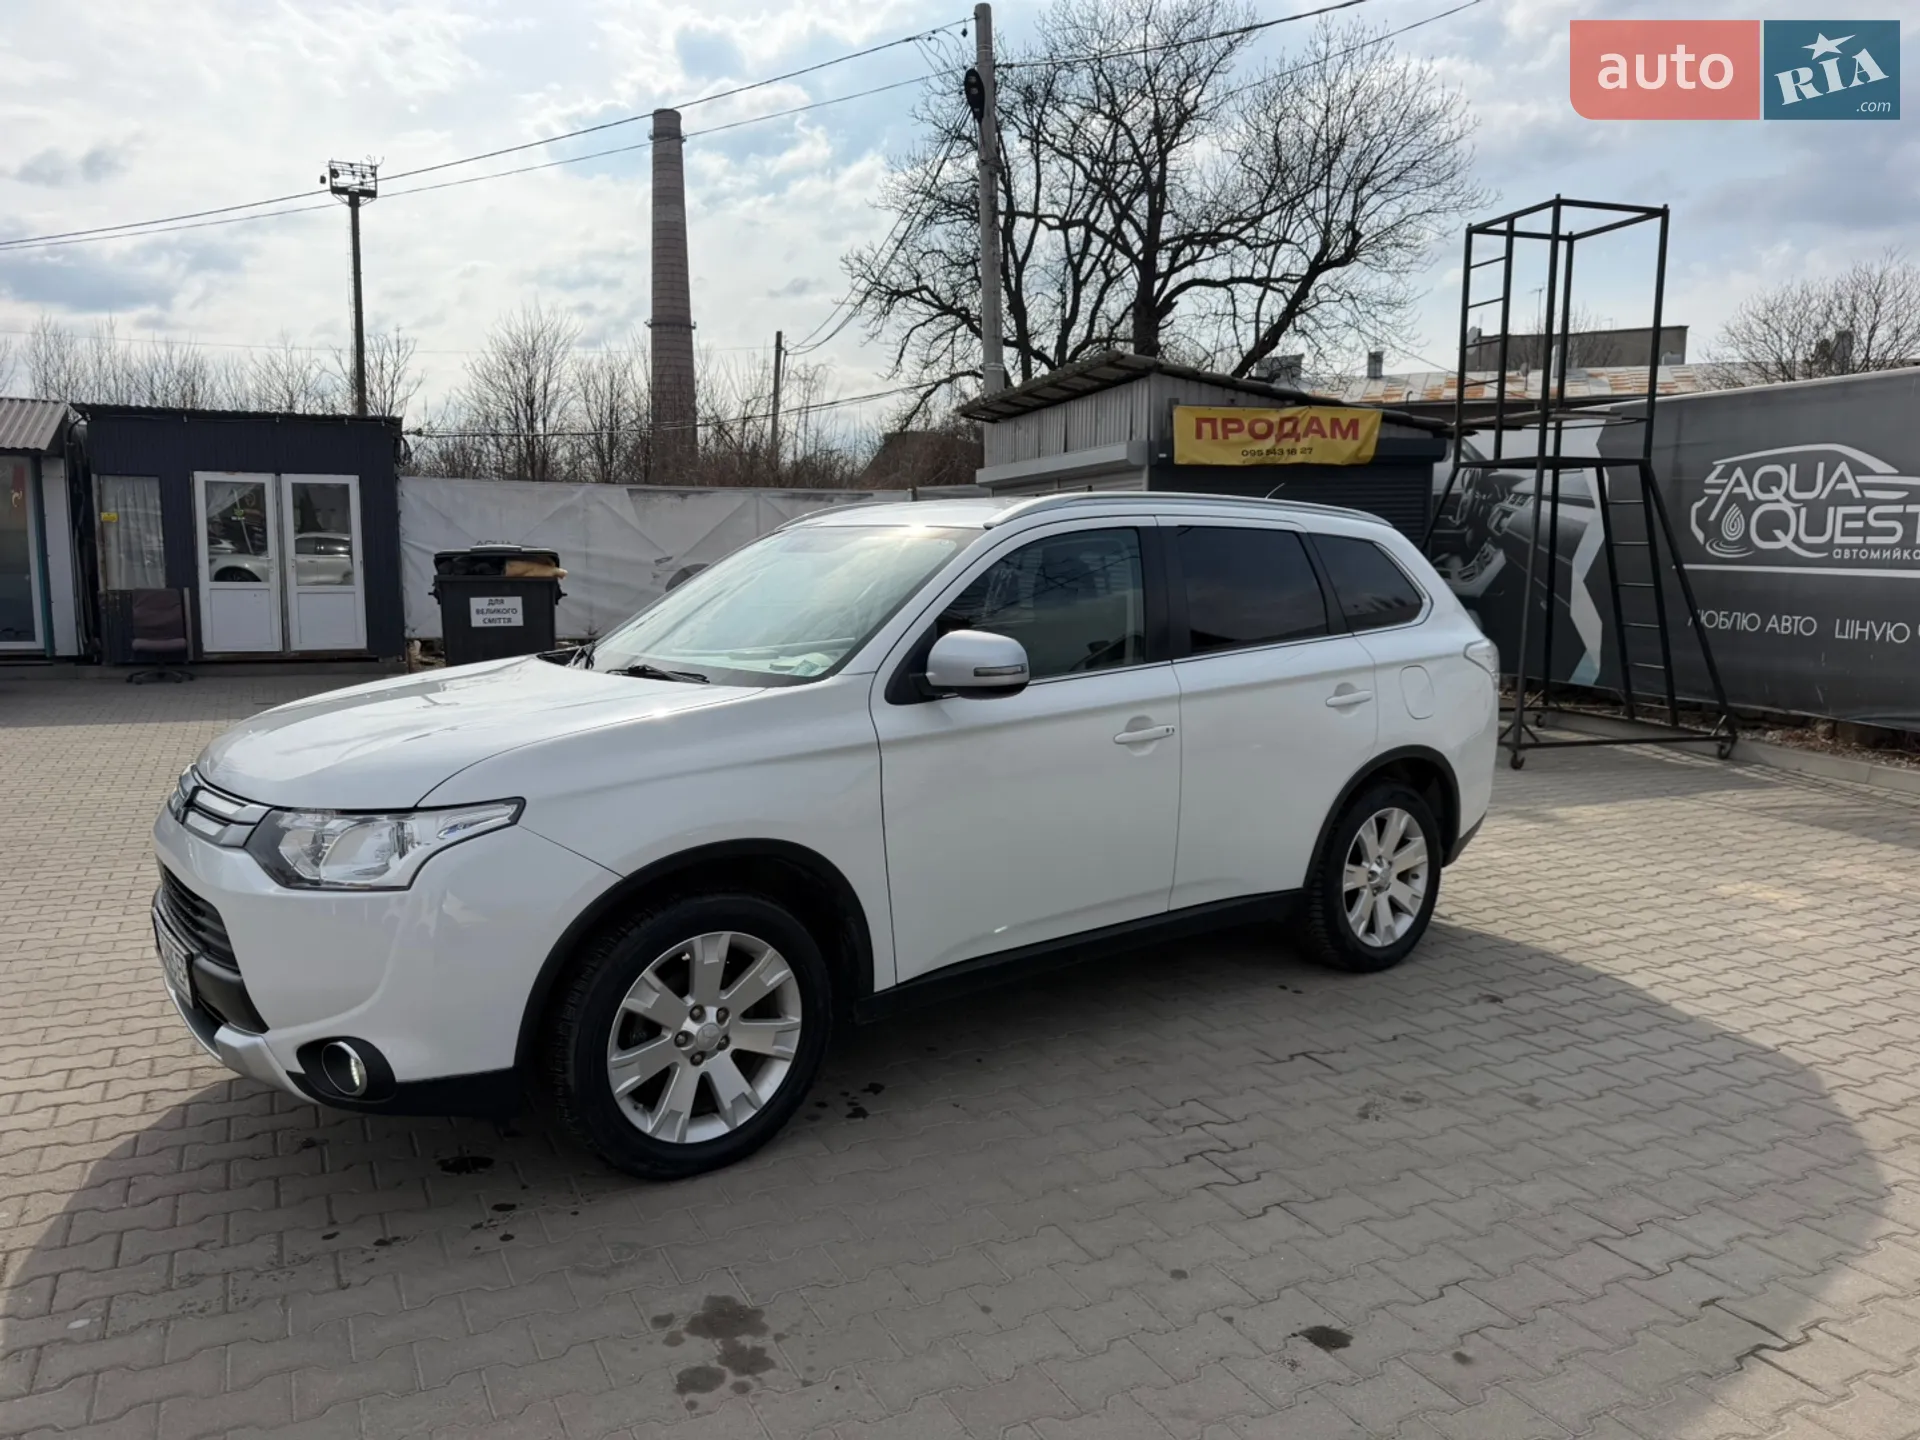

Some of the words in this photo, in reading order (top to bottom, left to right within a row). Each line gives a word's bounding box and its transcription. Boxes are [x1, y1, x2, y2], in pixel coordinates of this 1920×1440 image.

[1195, 416, 1359, 443] ПРОДАМ
[1709, 462, 1862, 520] AQUA
[487, 598, 505, 606] ДЛЯ
[475, 607, 518, 615] ВЕЛИКОГО
[482, 616, 512, 624] СМІТТЯ
[1765, 613, 1818, 636] АВТО
[1834, 618, 1911, 643] ЦІНУЮ
